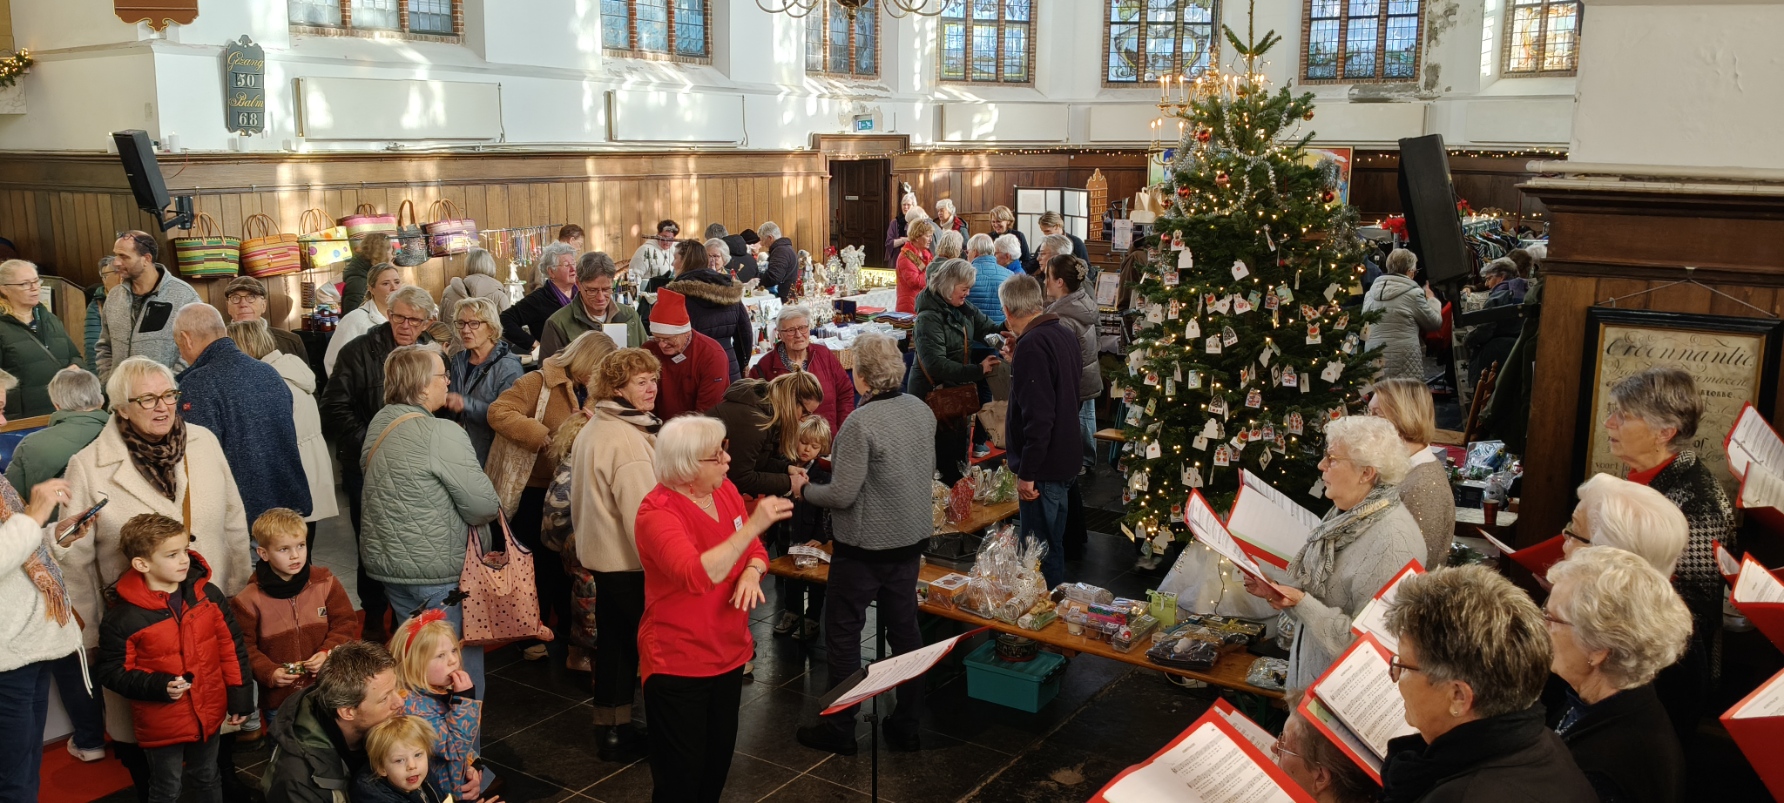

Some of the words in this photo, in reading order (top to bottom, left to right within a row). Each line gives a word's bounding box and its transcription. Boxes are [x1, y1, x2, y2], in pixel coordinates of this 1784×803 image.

[227, 51, 264, 72] Gezang
[237, 74, 255, 87] 50
[238, 112, 258, 126] 68
